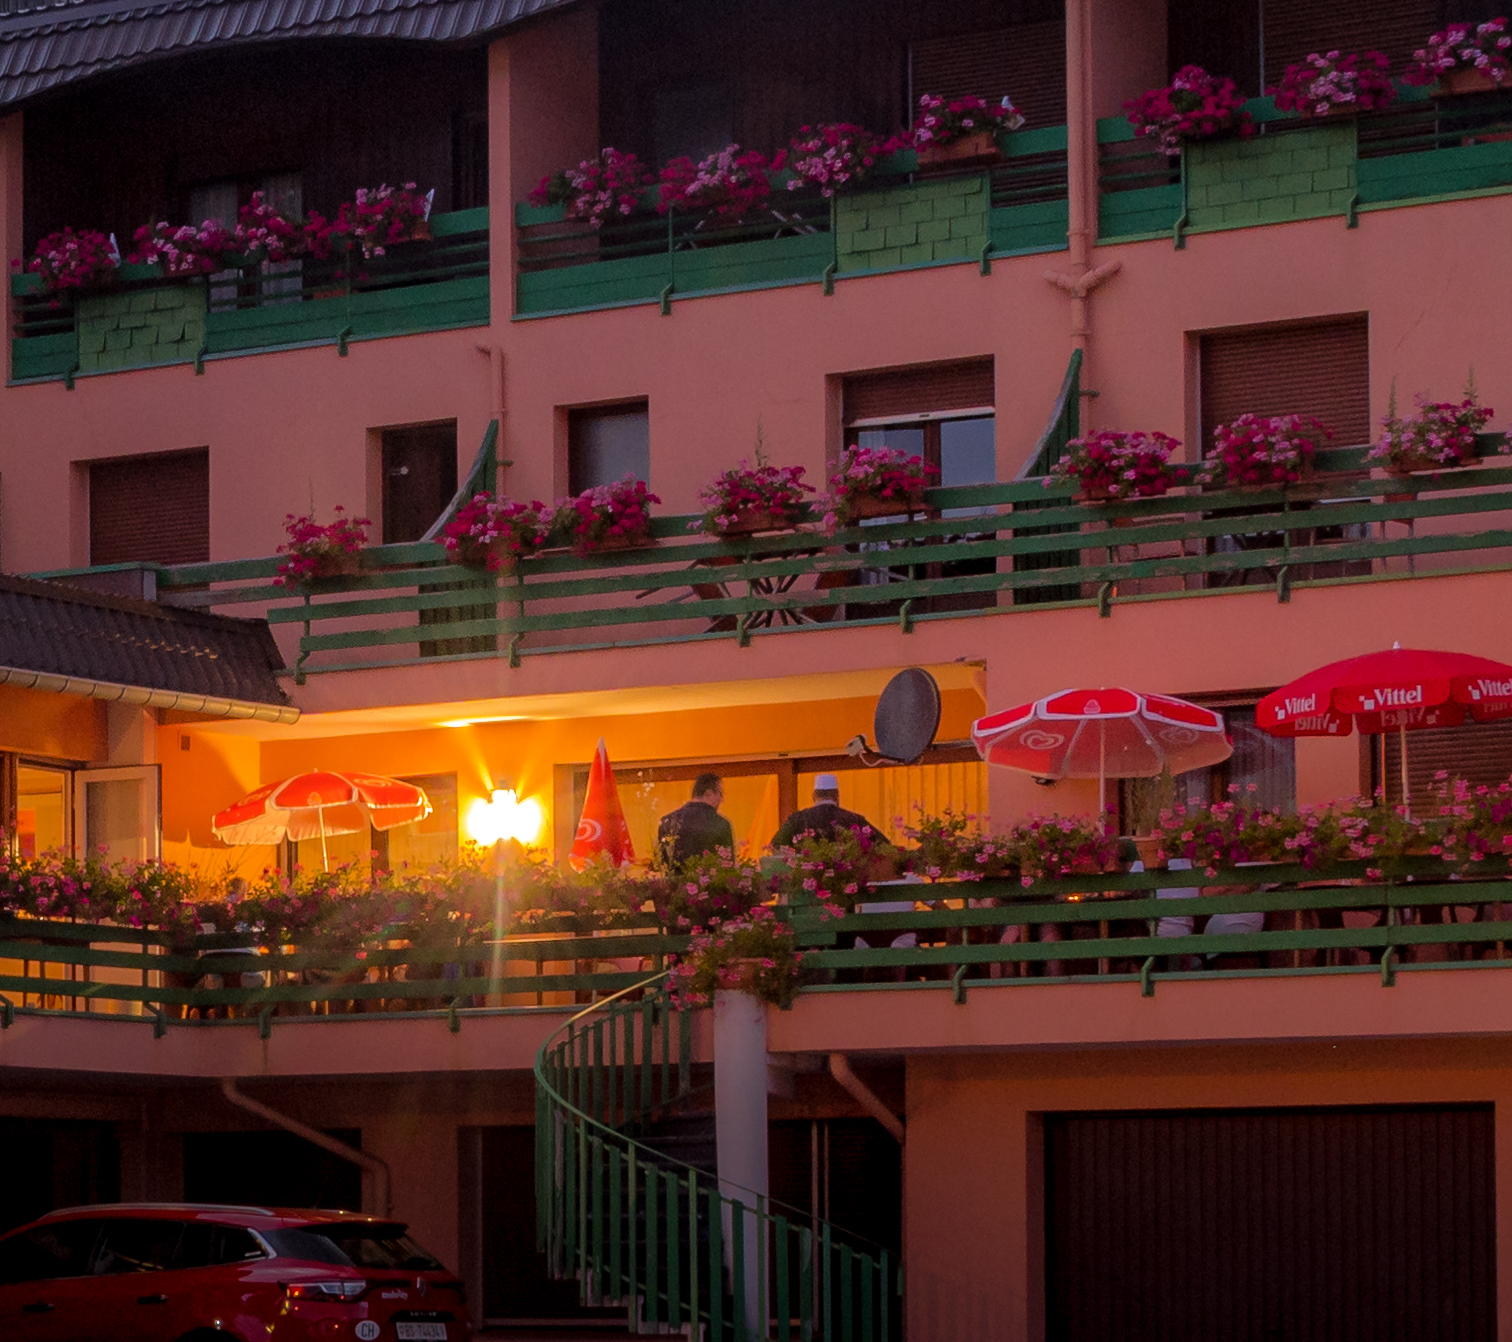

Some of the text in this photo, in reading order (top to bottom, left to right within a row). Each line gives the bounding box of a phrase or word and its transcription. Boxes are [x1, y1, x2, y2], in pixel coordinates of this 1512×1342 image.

[1285, 692, 1316, 715] Vittel
[1374, 684, 1423, 706] Vittel
[360, 1322, 375, 1338] CH
